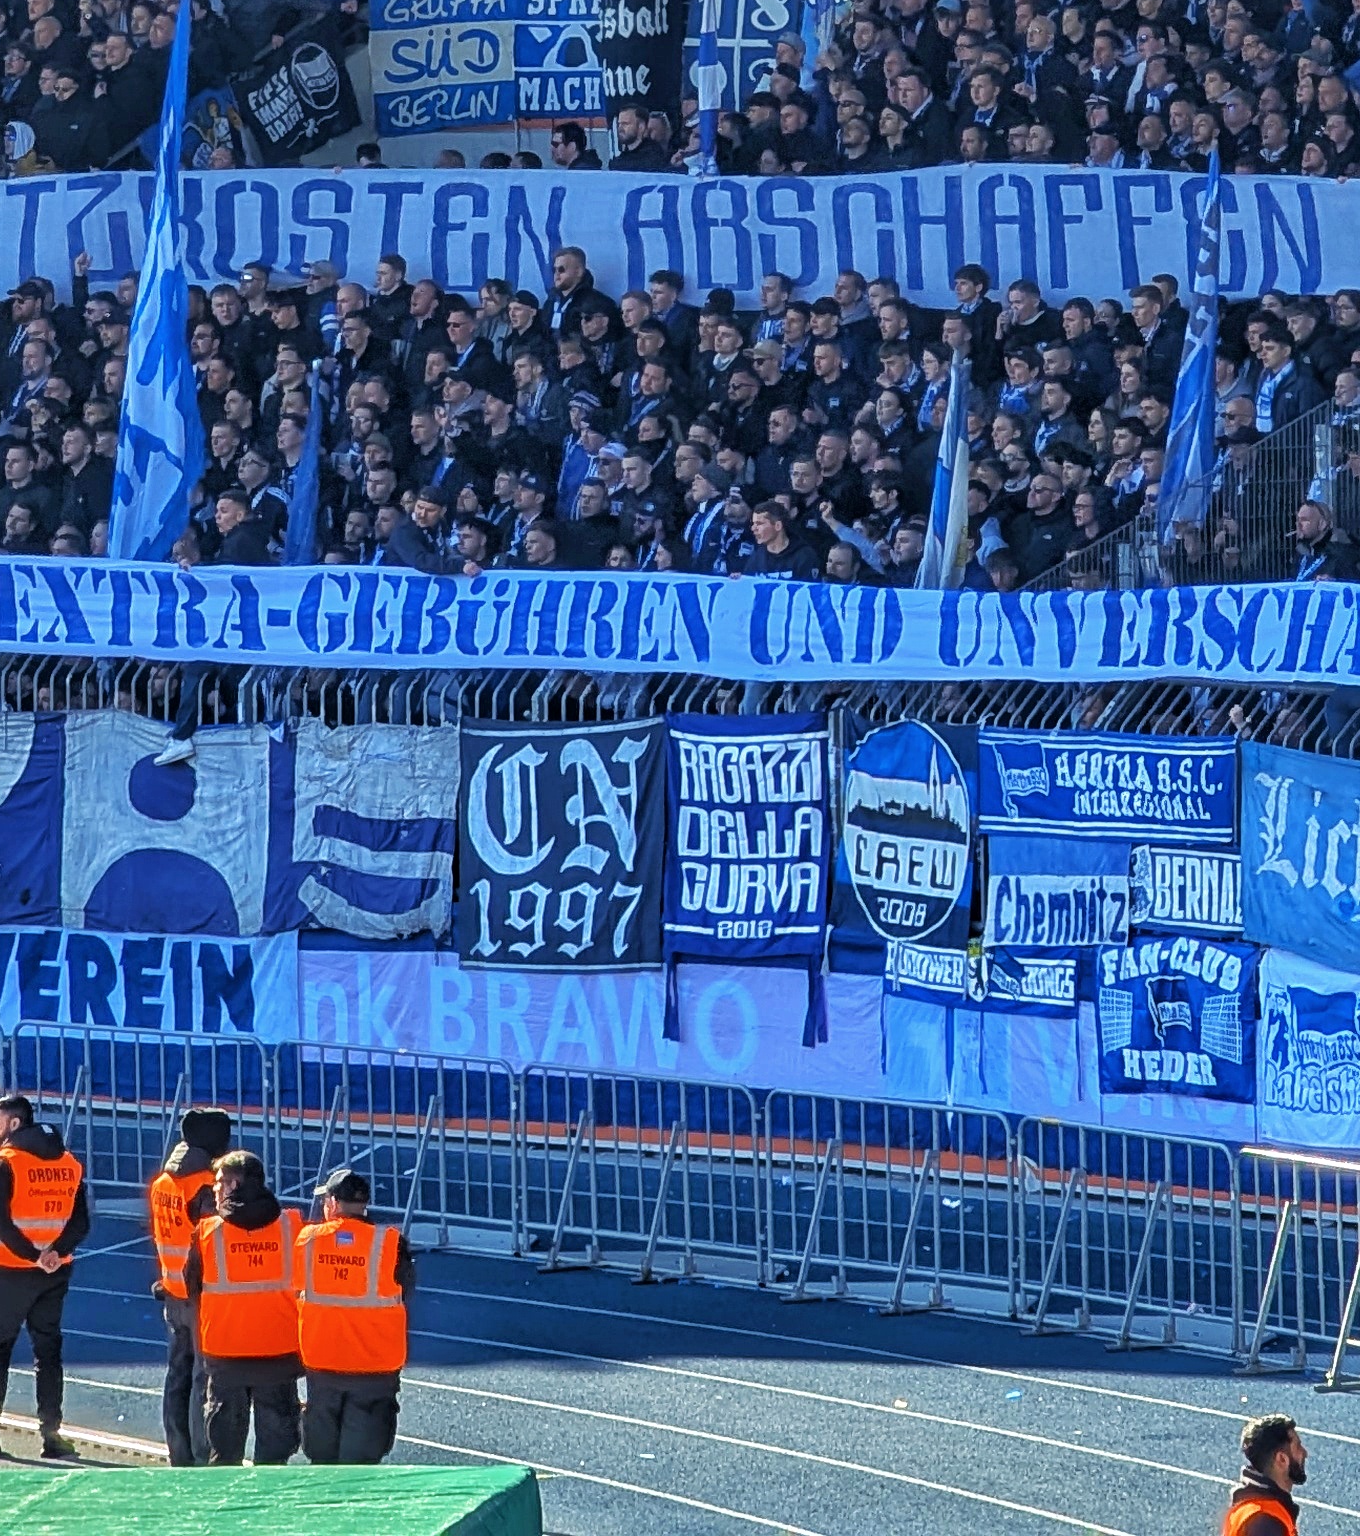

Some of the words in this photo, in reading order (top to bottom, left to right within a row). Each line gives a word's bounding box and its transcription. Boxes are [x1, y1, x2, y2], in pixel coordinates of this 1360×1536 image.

[383, 28, 501, 85] SÜD
[388, 85, 500, 128] BERLIN
[749, 582, 904, 665] UND
[678, 740, 823, 803] RAGAZZI
[1054, 750, 1153, 793] HERTHA
[1157, 757, 1224, 796] B.S.C.
[677, 806, 822, 858] DELLA
[680, 861, 820, 915] CURVA
[876, 896, 928, 928] 2008
[993, 875, 1127, 945] Chemnitz
[469, 880, 643, 959] 1997
[1021, 966, 1075, 999] JUNGS
[1101, 936, 1242, 993] FAN-CLUB
[430, 964, 758, 1076] BRAWO
[1122, 1048, 1218, 1087] HEDER
[27, 1167, 75, 1184] ORDNER
[230, 1241, 279, 1253] STEWARD
[317, 1253, 366, 1267] STEWARD
